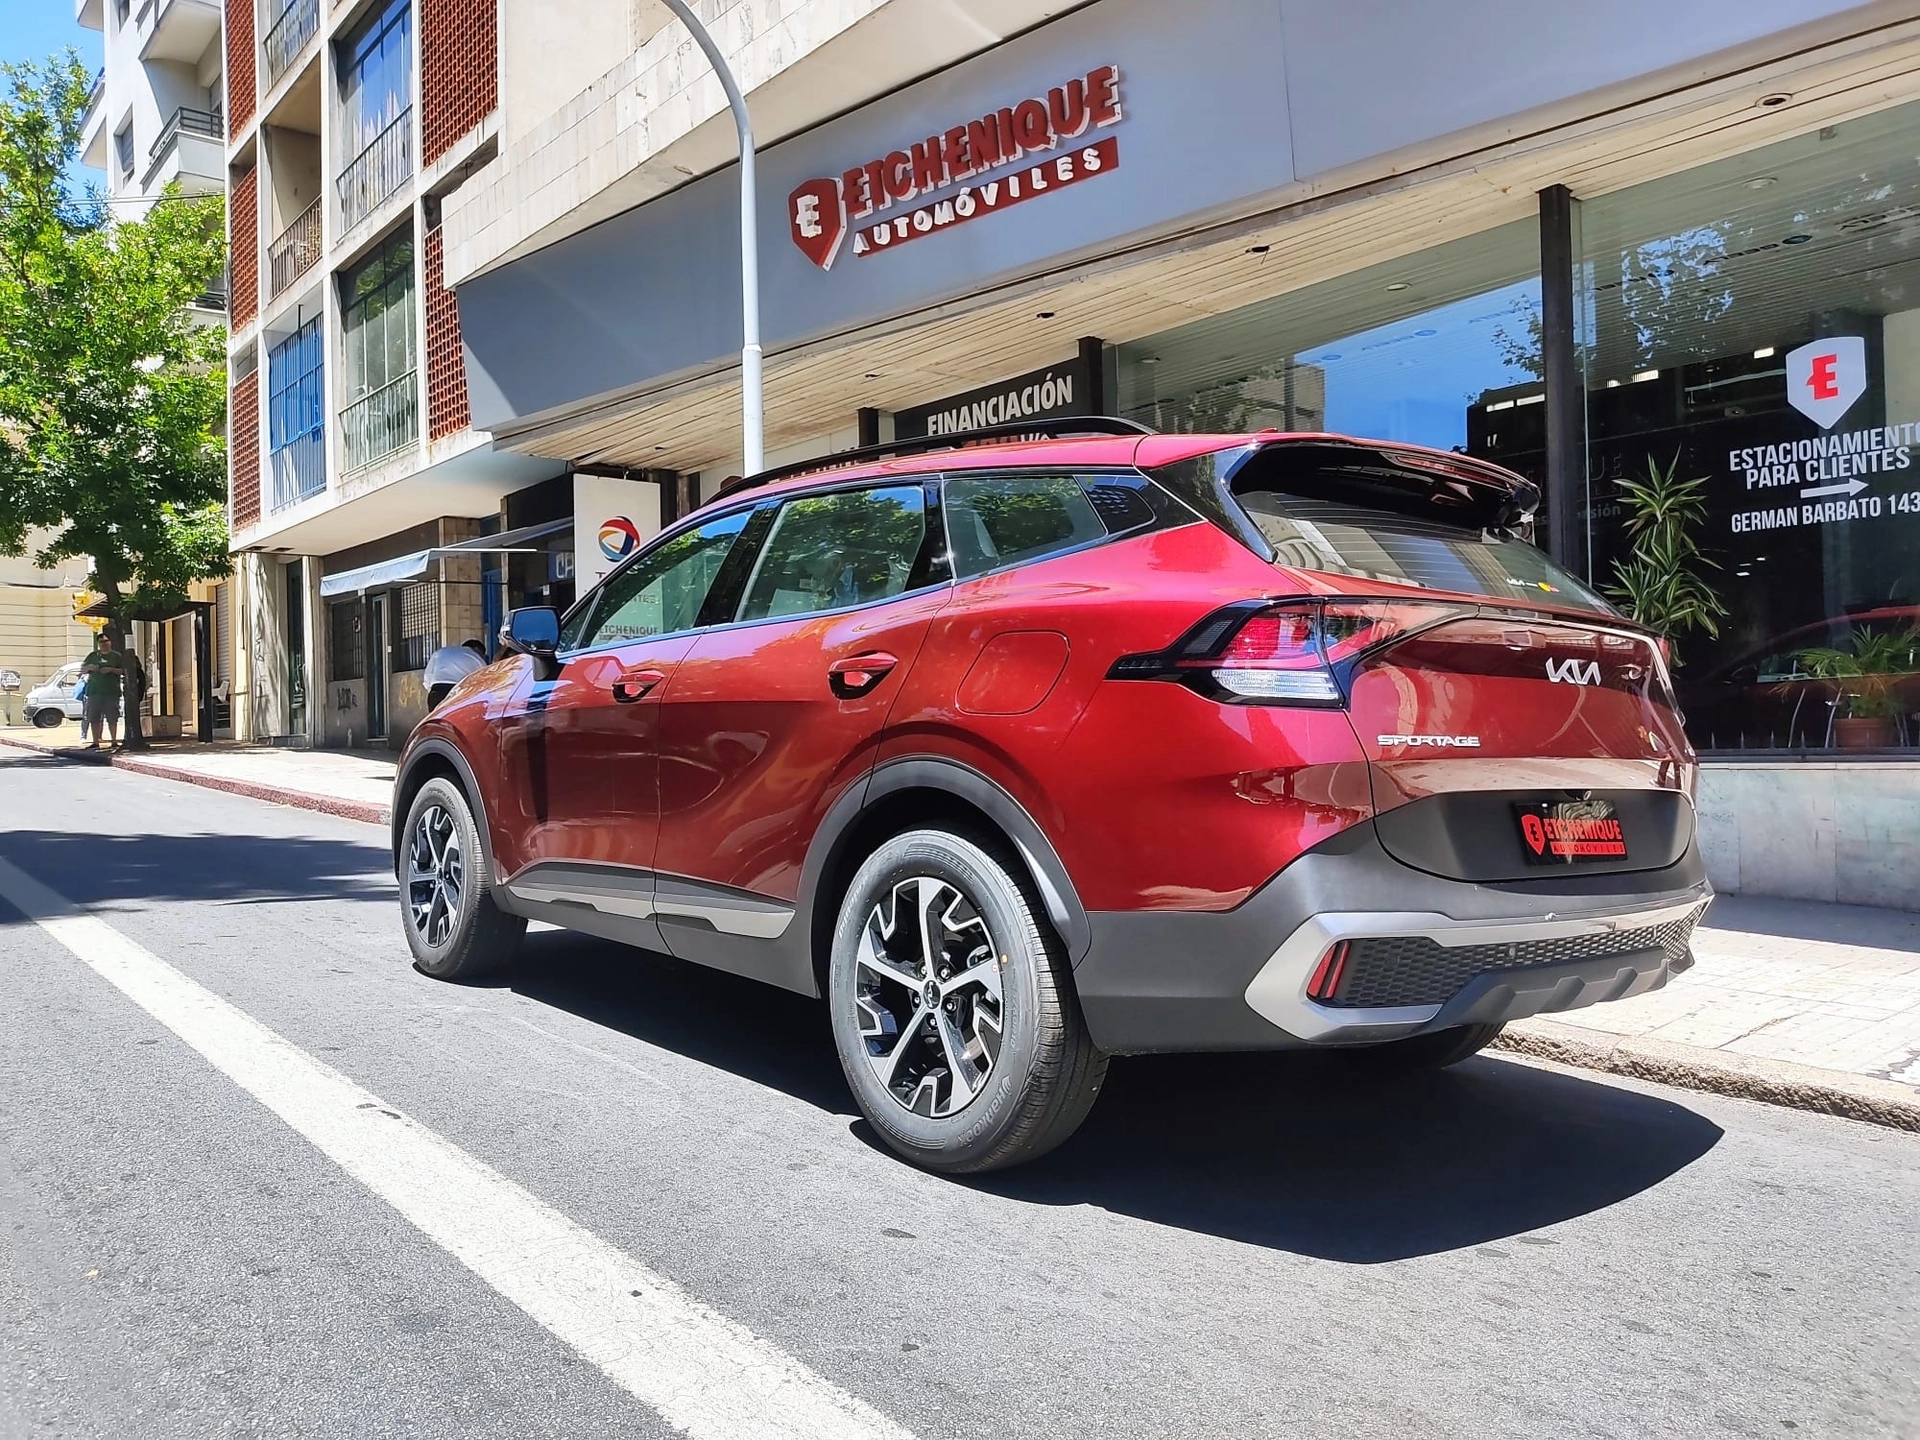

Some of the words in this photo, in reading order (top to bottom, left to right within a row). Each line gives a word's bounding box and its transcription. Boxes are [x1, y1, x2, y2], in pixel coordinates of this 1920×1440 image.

[842, 64, 1121, 220] ETCHENIQUE
[853, 148, 1101, 254] AUTOMÓVILES
[1806, 353, 1839, 400] E
[927, 372, 1072, 435] FINANCIACIÓN
[1746, 464, 1800, 490] PARA
[1805, 446, 1910, 482] CLIENTES
[1731, 507, 1797, 533] GERMAN
[1802, 496, 1881, 524] BARBATO
[1377, 735, 1480, 747] SPORTAGE
